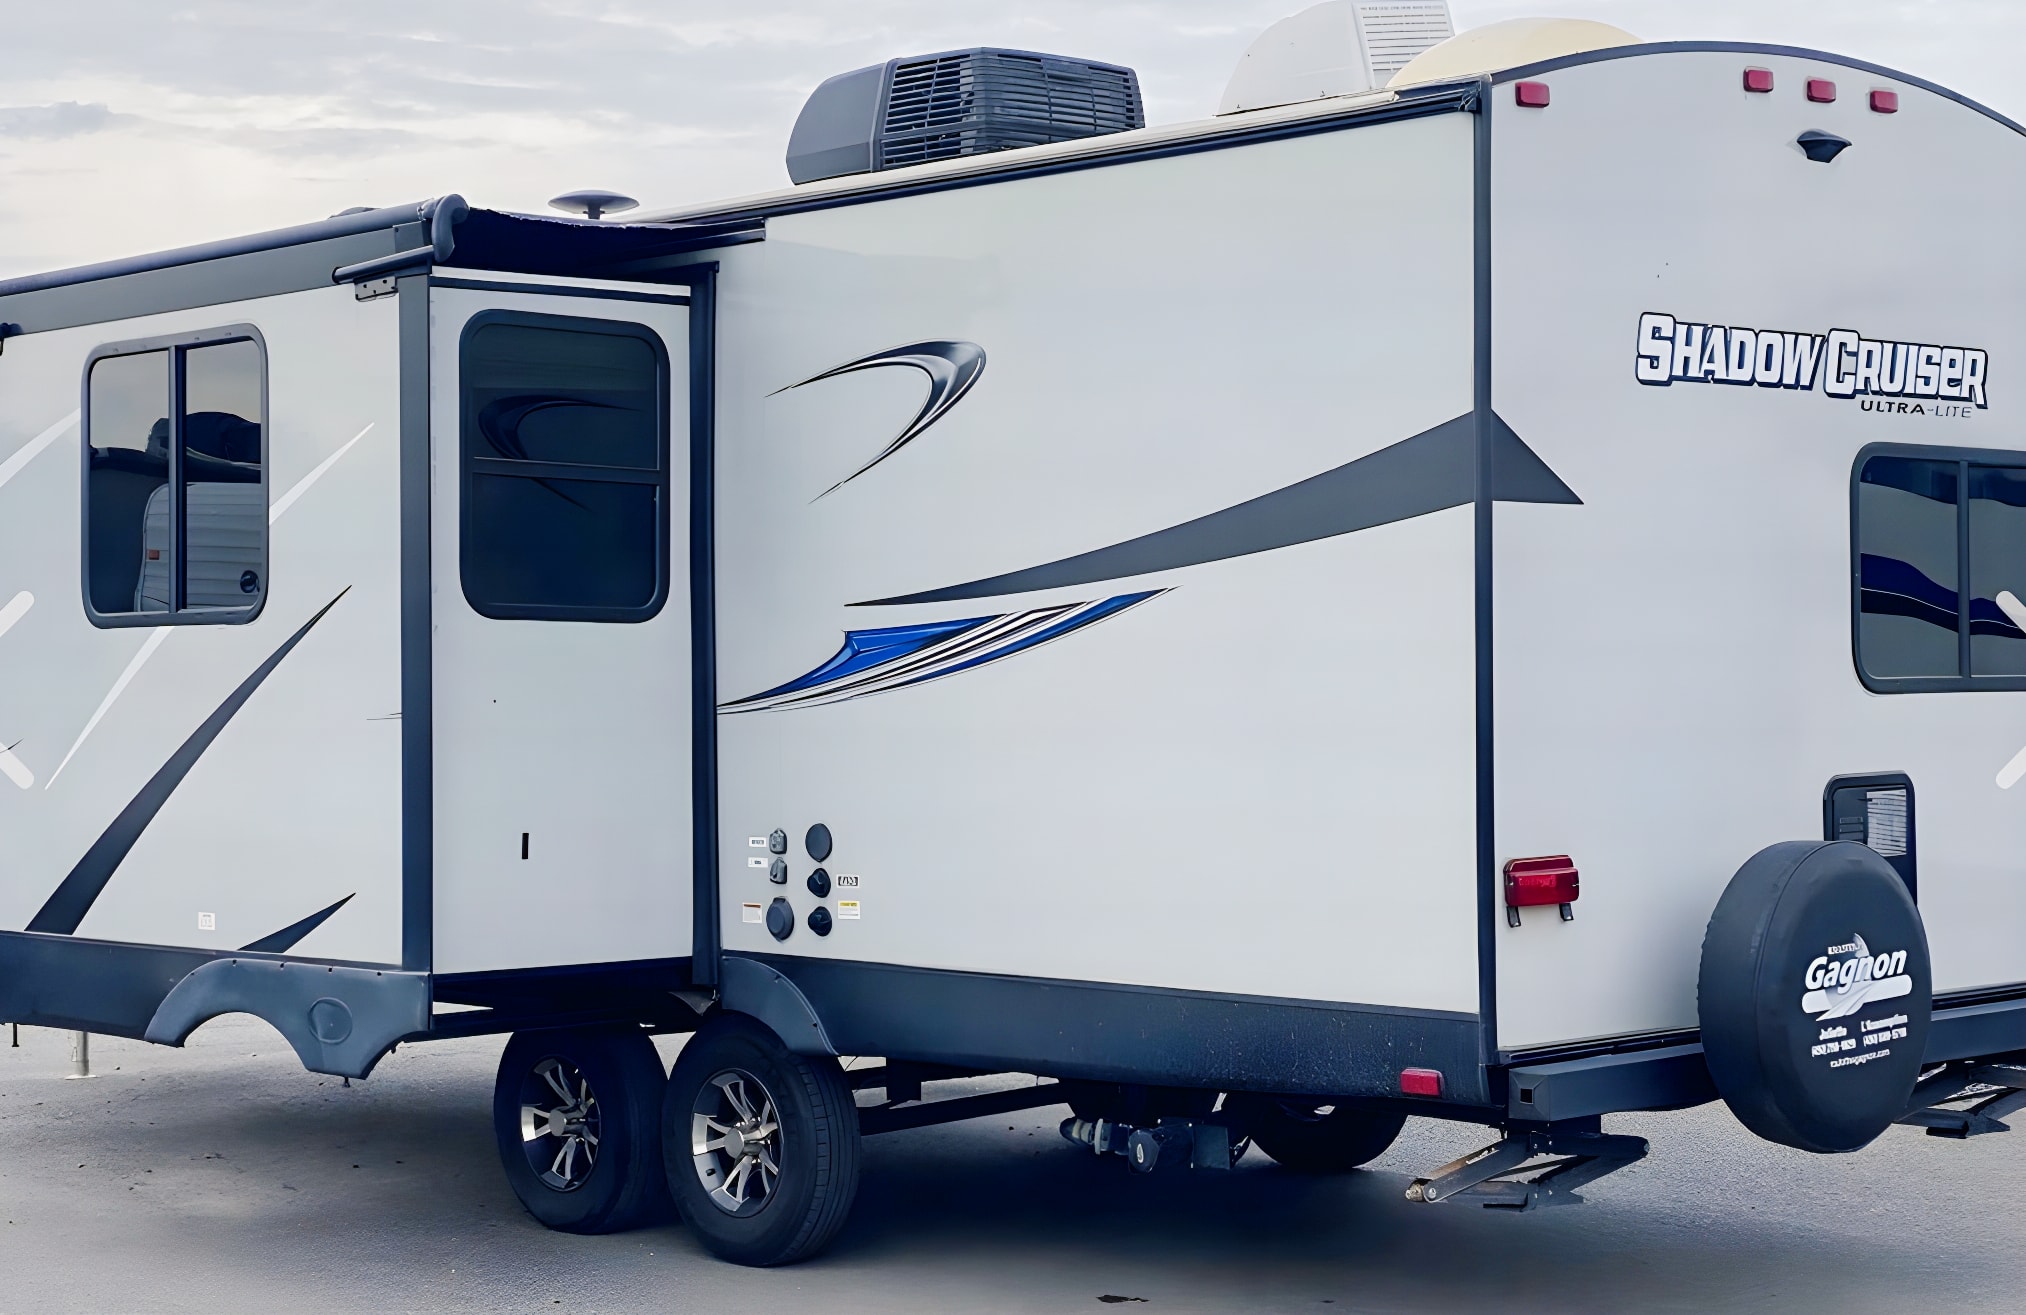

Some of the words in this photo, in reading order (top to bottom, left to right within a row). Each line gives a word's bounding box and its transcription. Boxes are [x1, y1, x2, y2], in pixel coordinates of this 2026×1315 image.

[1636, 312, 1827, 391] SHADOW
[1823, 328, 1989, 410] CRUISER
[1860, 400, 1973, 419] ULTRA-LITE
[1805, 950, 1907, 994] Gagnon
